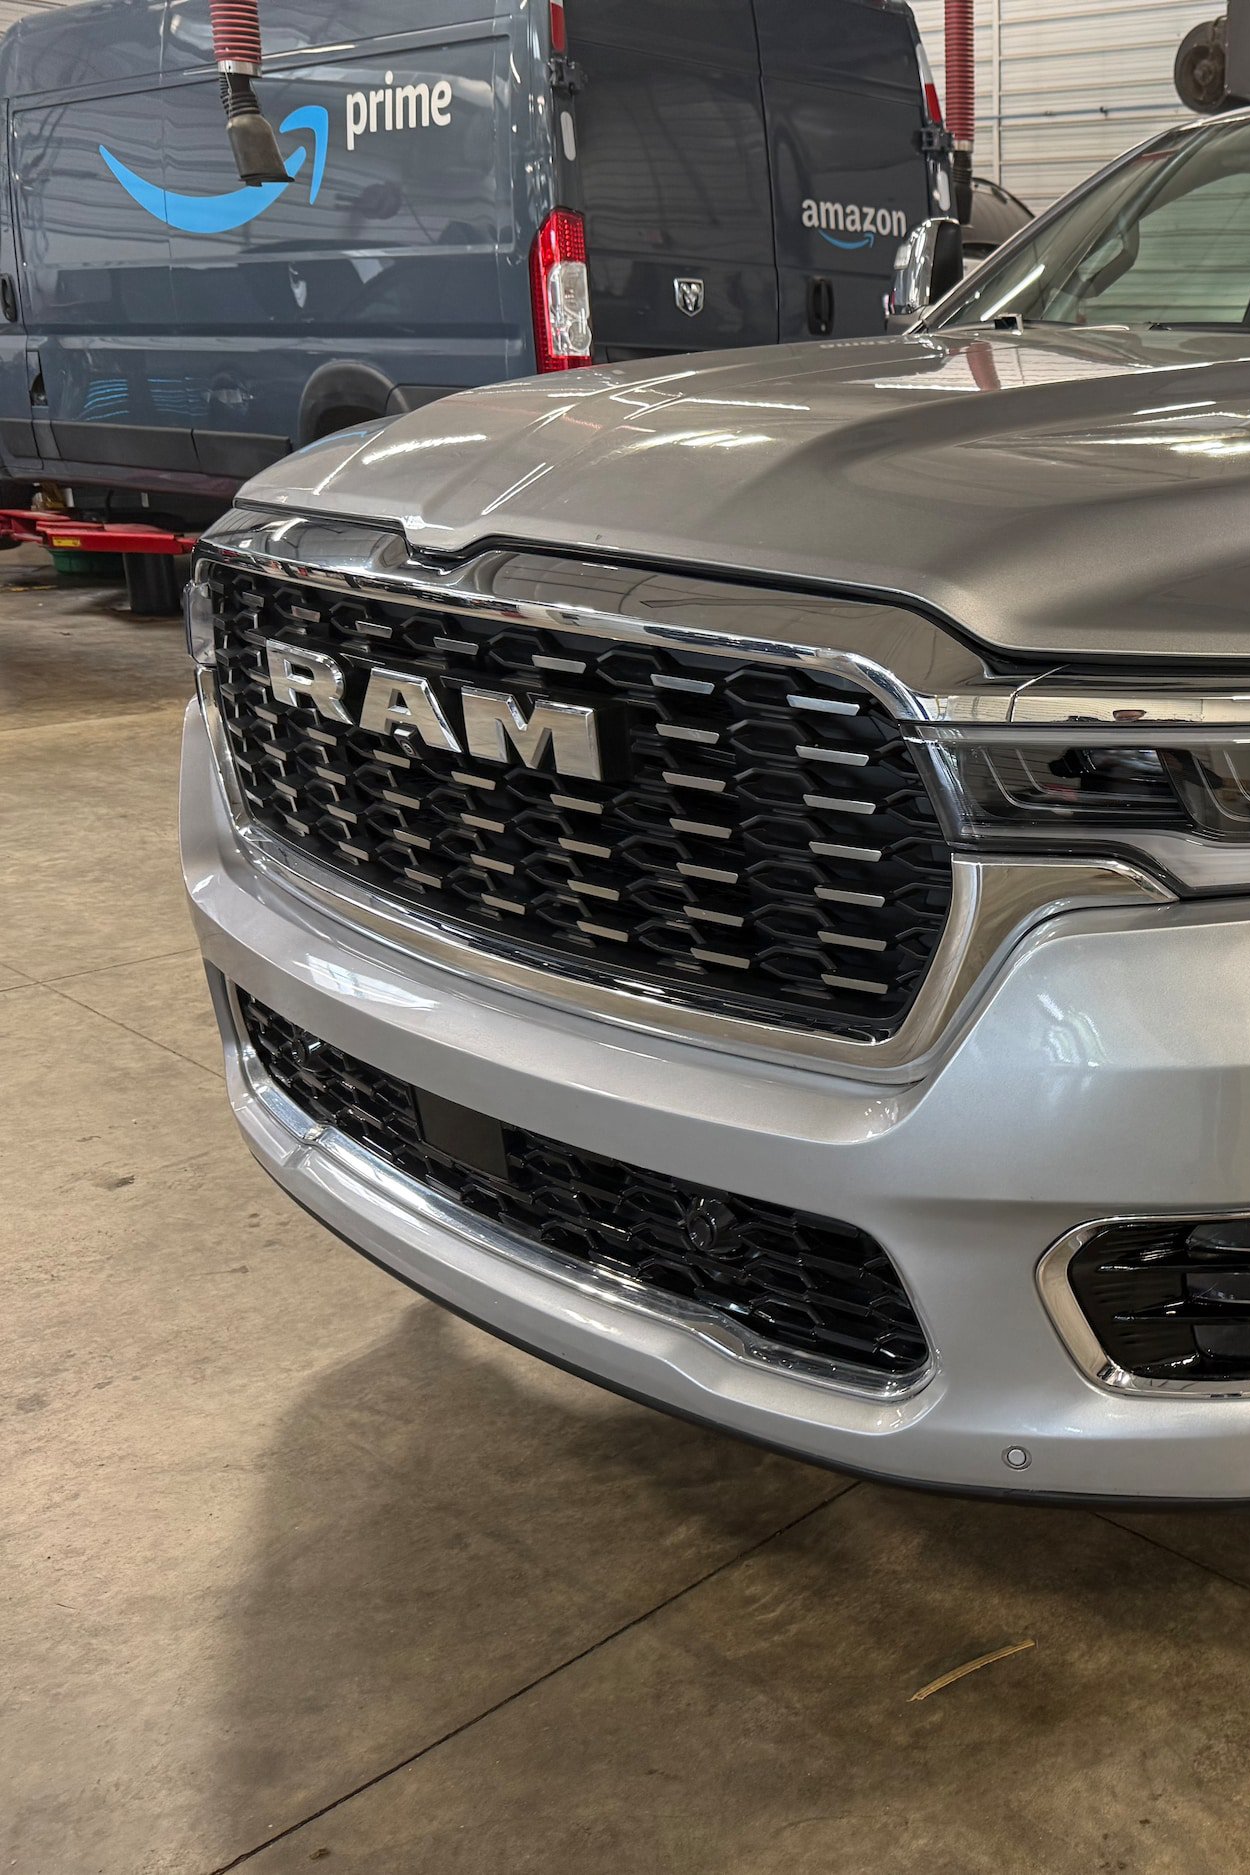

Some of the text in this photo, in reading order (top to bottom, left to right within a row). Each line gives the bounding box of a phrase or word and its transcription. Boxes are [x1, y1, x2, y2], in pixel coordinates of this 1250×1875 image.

[346, 70, 452, 151] prime
[801, 198, 907, 238] amazon
[265, 637, 602, 782] RAM
